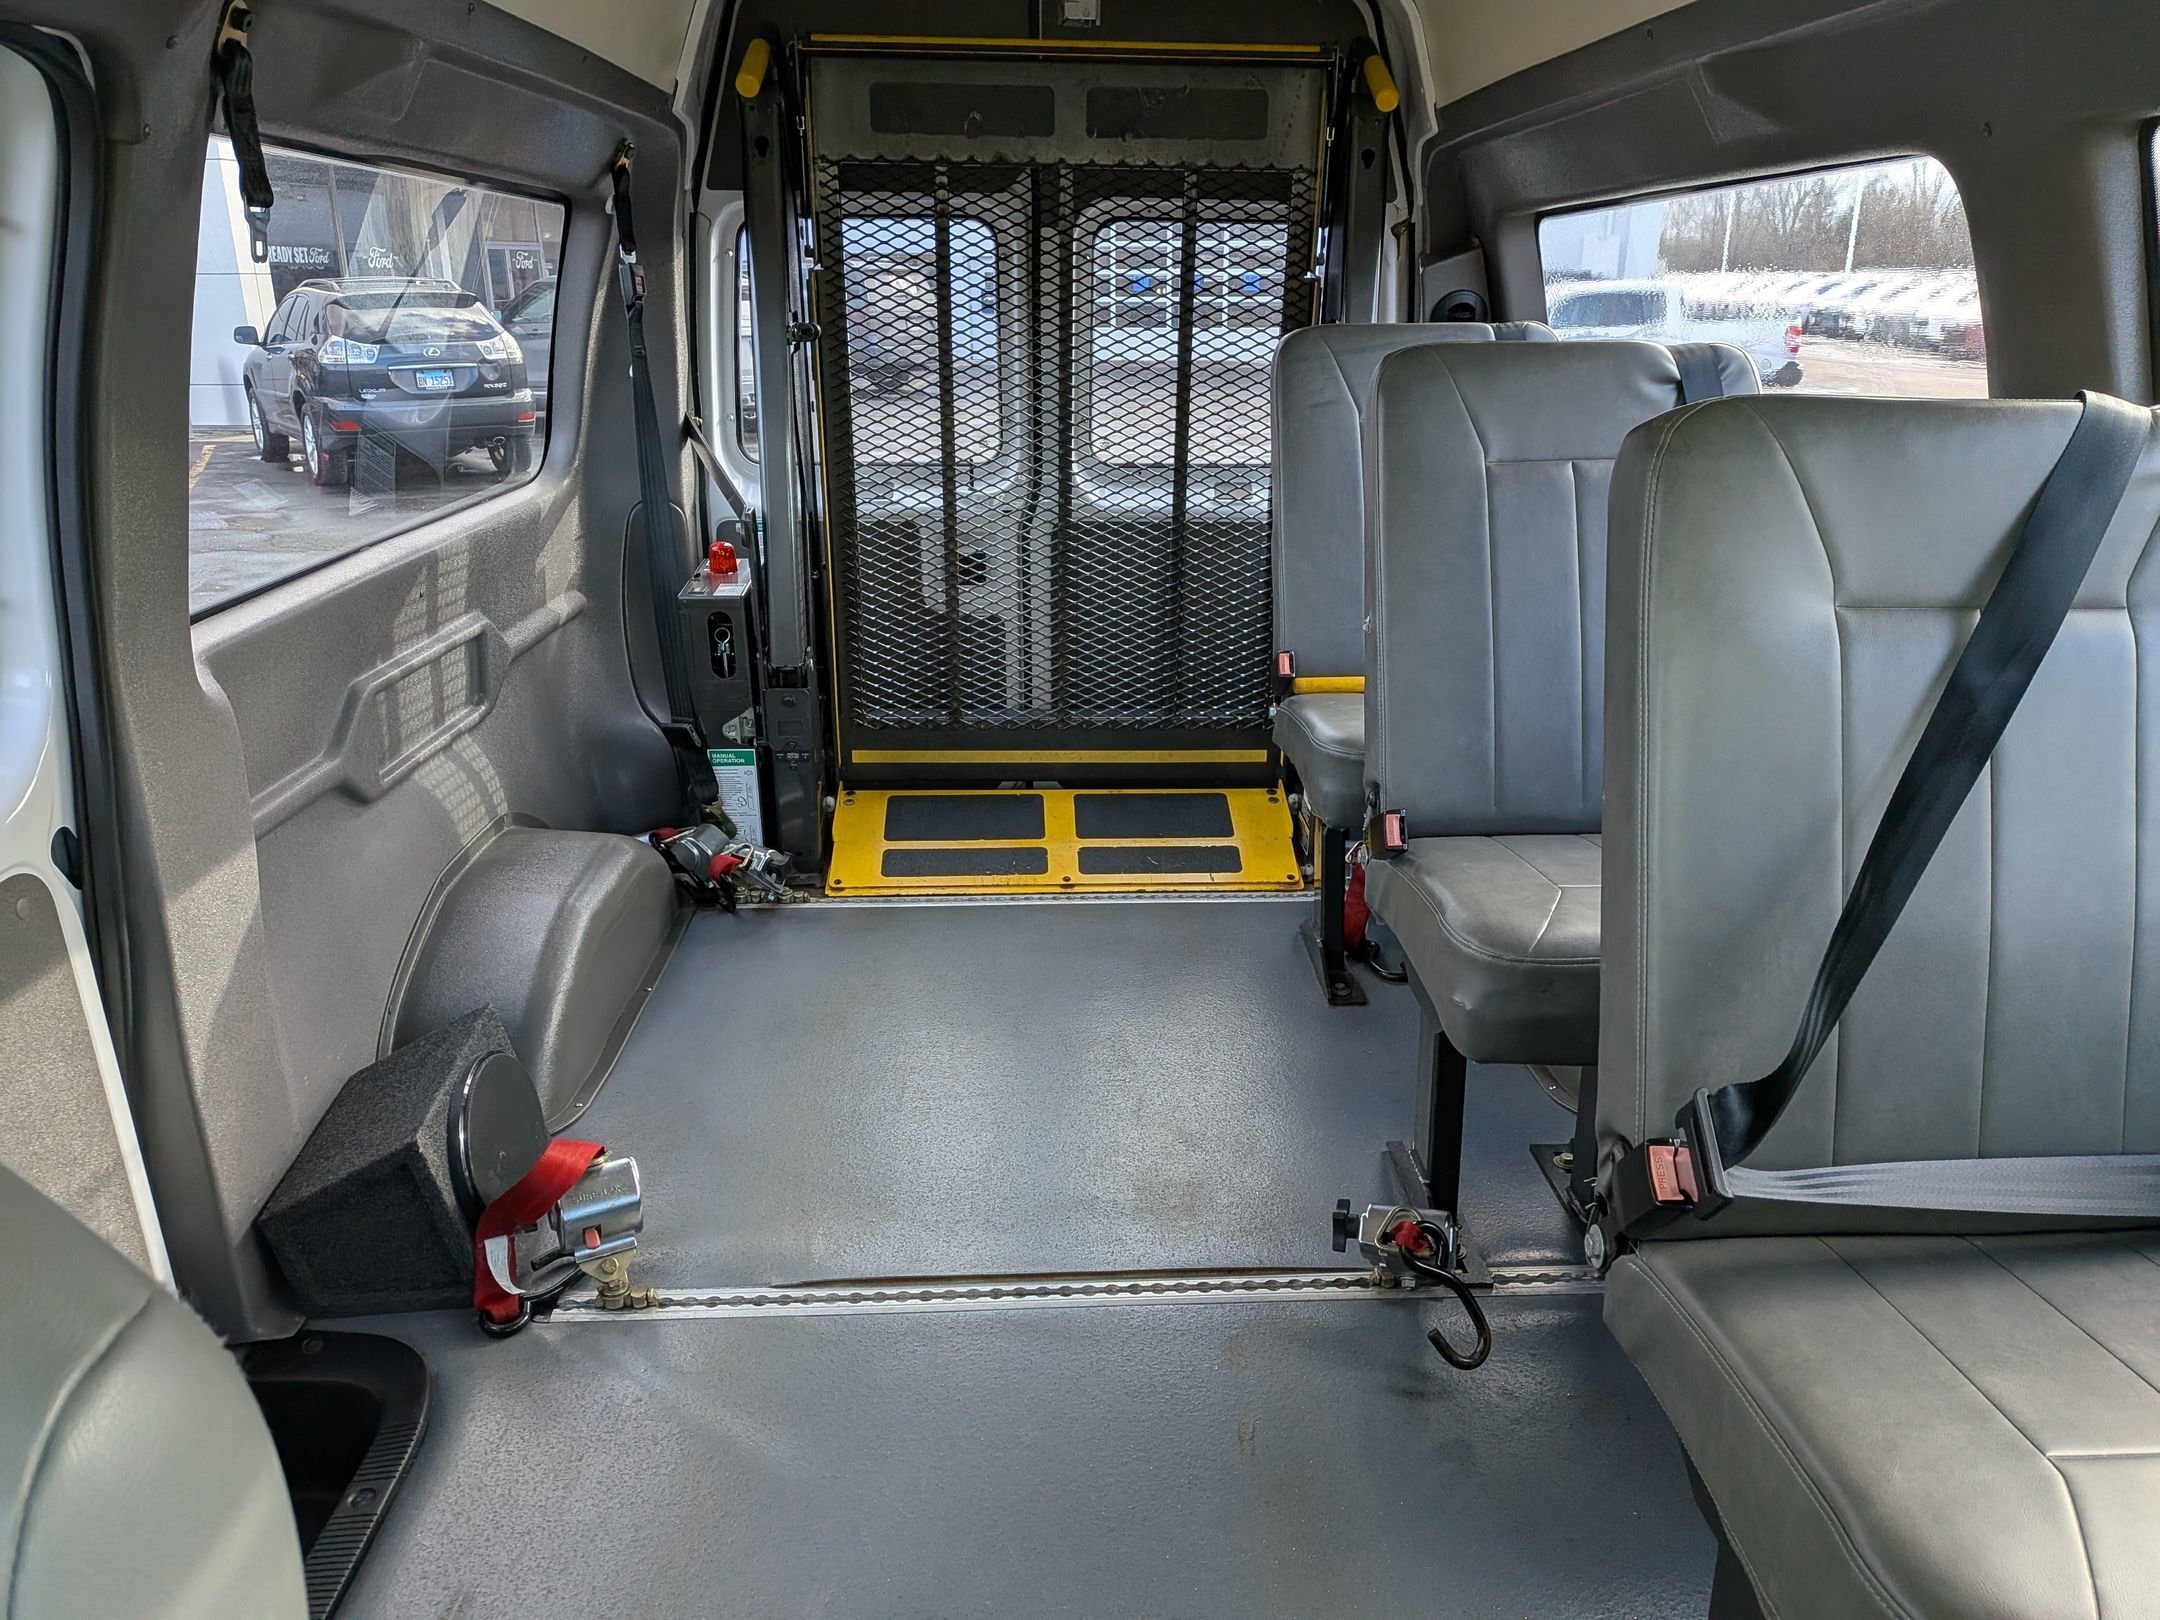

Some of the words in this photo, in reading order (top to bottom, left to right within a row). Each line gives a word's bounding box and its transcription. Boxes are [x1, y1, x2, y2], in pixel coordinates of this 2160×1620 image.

[293, 246, 308, 264] SET
[308, 247, 330, 264] Ford
[367, 246, 394, 269] Ford
[514, 250, 535, 270] Ford
[1654, 1155, 1668, 1190] PRESS
